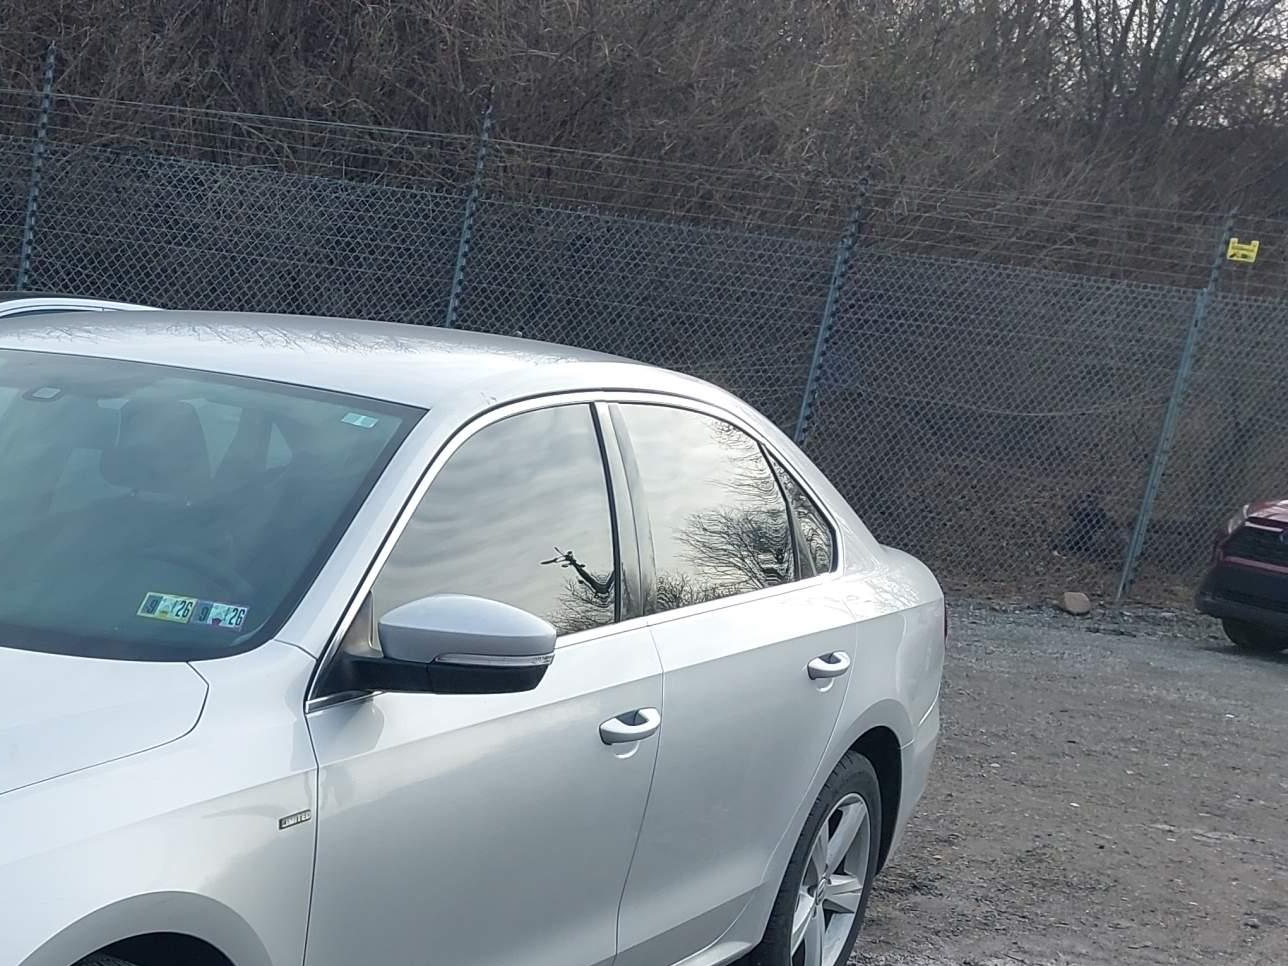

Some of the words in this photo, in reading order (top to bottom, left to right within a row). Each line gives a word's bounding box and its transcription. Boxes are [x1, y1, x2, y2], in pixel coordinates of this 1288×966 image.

[175, 600, 193, 618] 26
[199, 606, 210, 622] 9
[228, 607, 246, 626] 26
